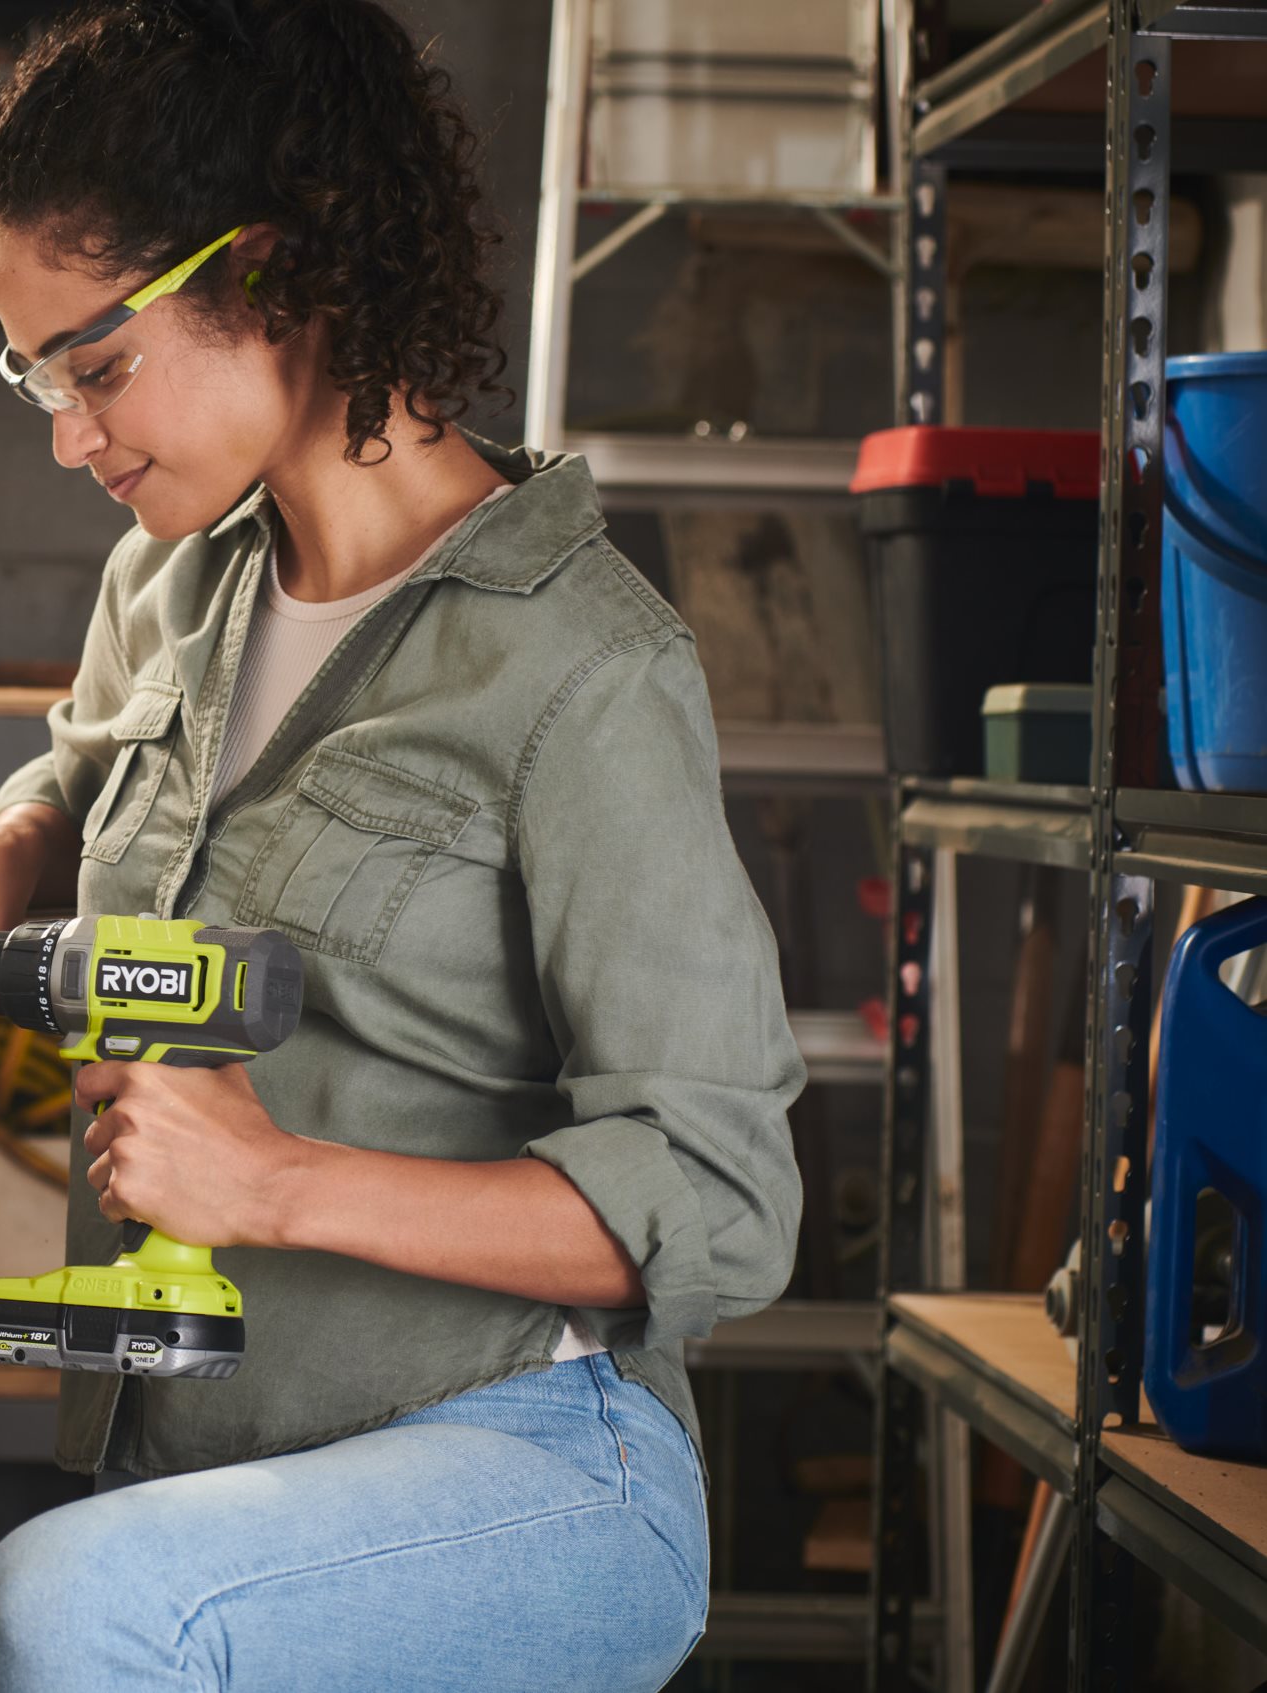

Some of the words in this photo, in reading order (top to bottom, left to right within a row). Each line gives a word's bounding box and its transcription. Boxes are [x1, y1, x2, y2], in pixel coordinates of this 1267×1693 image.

[43, 938, 54, 953] 20
[38, 966, 47, 982] 18
[101, 964, 187, 996] RYOBI
[39, 997, 48, 1011] 16
[30, 1332, 51, 1342] 18V
[131, 1341, 156, 1351] RYOBI
